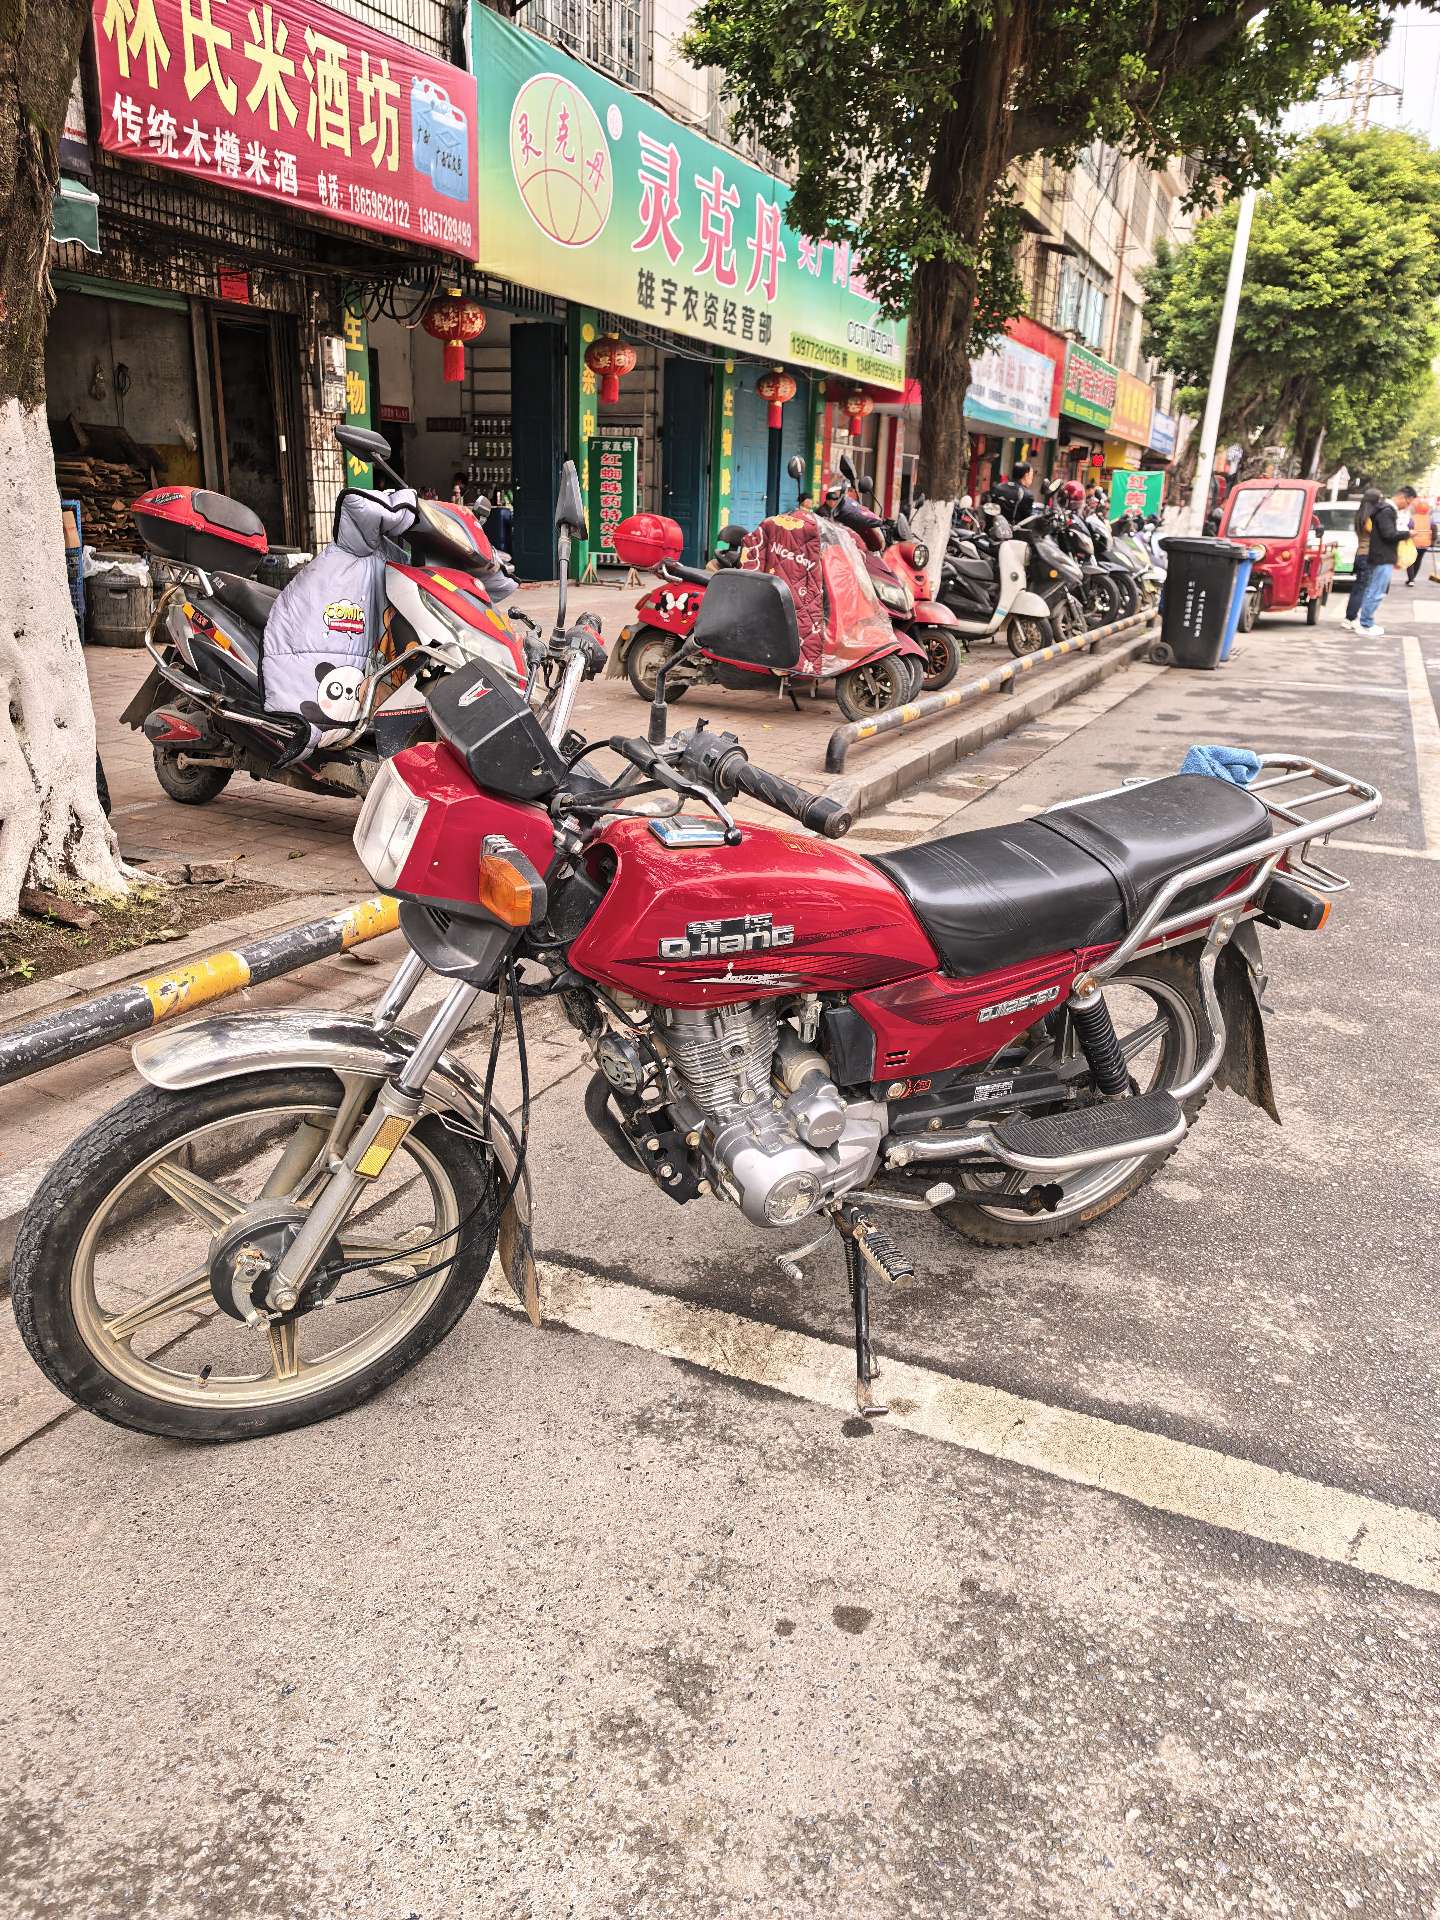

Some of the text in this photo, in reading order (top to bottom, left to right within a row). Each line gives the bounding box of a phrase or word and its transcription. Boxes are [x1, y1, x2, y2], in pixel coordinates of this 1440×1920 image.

[102, 0, 401, 172] 林氏米酒坊
[112, 92, 299, 197] 传统木樽米酒
[348, 183, 411, 228] 13659623122
[417, 207, 472, 248] 13457289499
[631, 131, 787, 304] 灵克丹
[636, 267, 773, 346] 雄宇农资经营部
[770, 541, 816, 573] Nice day
[325, 604, 365, 622] COMIC
